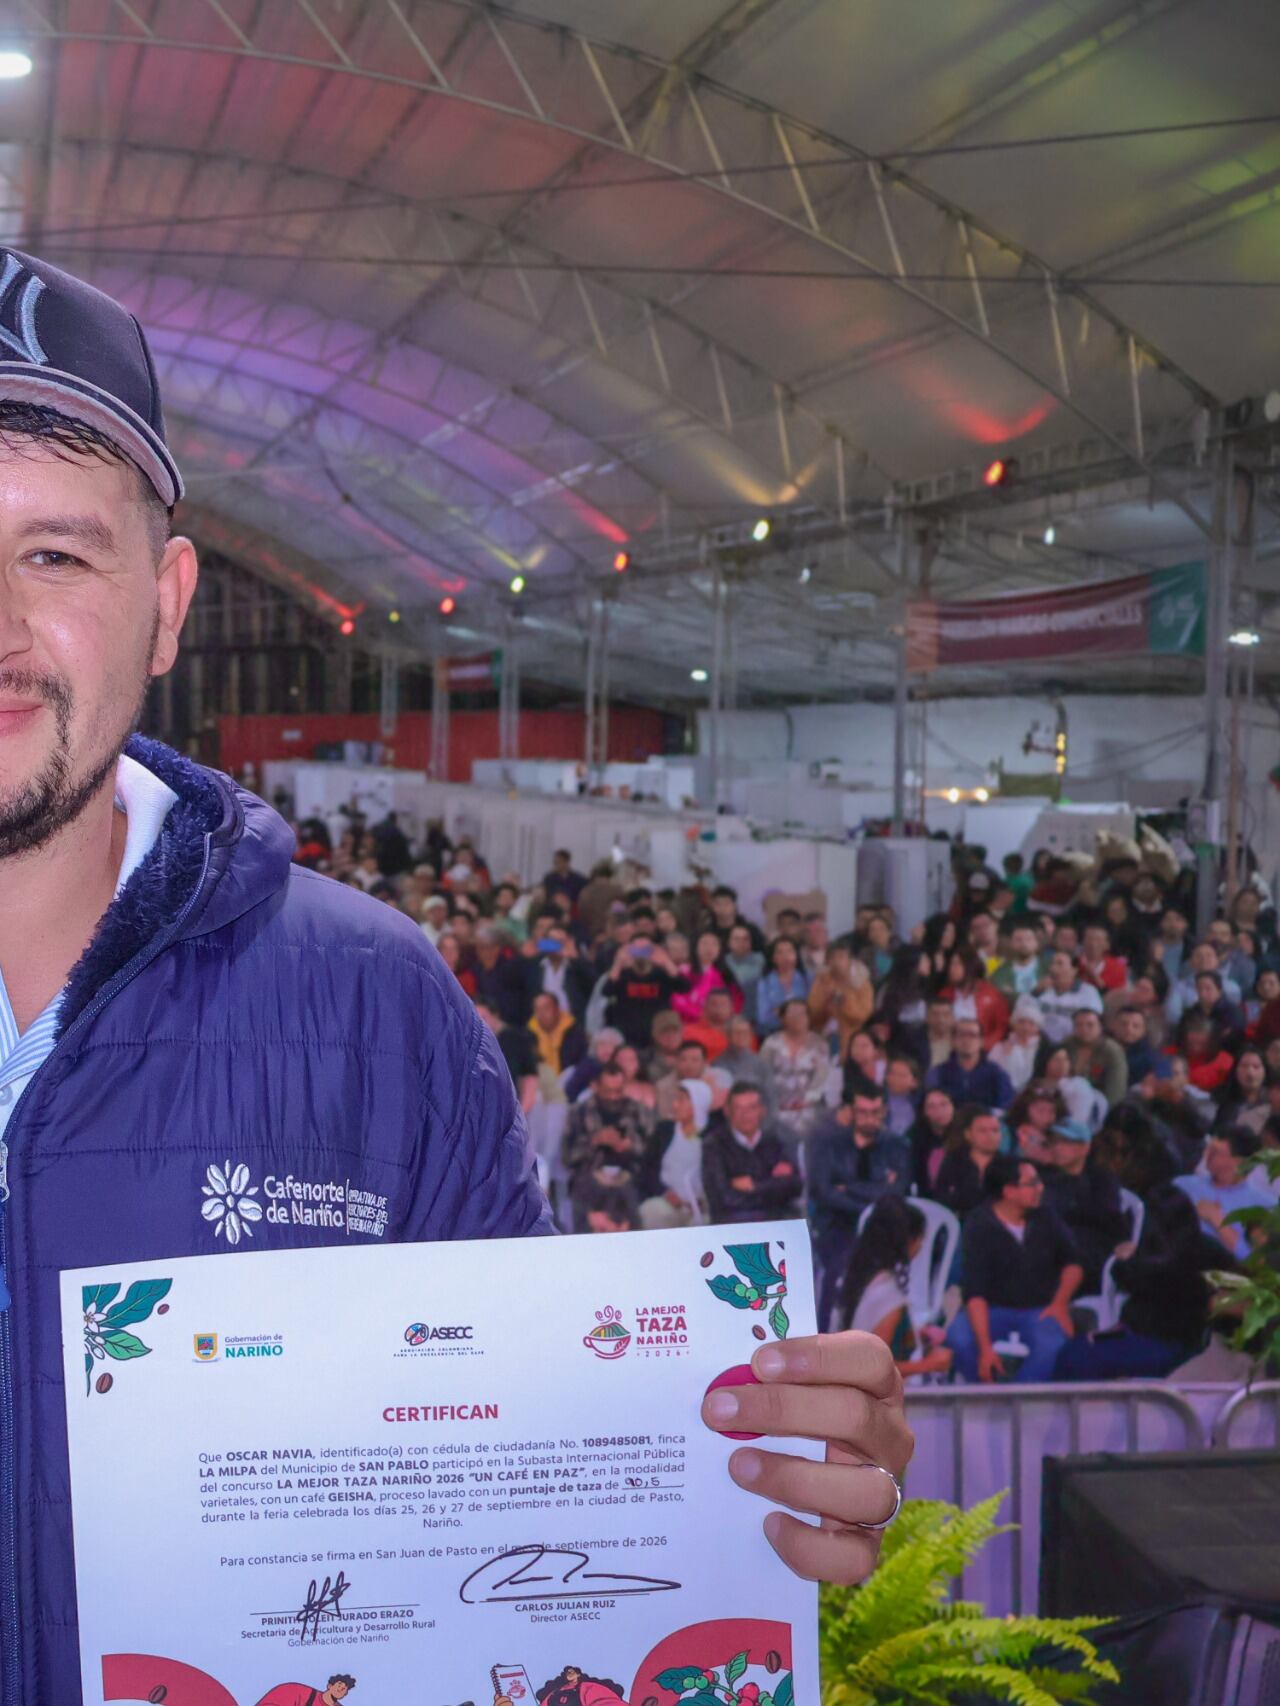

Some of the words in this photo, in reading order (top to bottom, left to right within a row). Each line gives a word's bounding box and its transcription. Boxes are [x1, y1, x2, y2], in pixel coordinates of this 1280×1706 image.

[263, 1174, 345, 1203] Cafenorte
[266, 1200, 289, 1224] de
[292, 1202, 345, 1227] Nariño
[635, 1307, 649, 1316] LA
[651, 1305, 686, 1315] MEJOR
[636, 1316, 687, 1332] TAZA
[224, 1334, 272, 1343] Gobernación
[429, 1326, 473, 1340] ASECC
[636, 1332, 688, 1345] NARIÑO
[225, 1342, 283, 1358] NARIÑO
[382, 1404, 498, 1422] CERTIFICAN
[198, 1451, 222, 1466] Que
[226, 1449, 268, 1461] OSCAR
[272, 1448, 315, 1462] NAVIA,
[320, 1443, 402, 1459] identificado(a)
[407, 1445, 428, 1454] con
[432, 1441, 470, 1453] cédula
[474, 1440, 489, 1452] de
[493, 1438, 555, 1451] ciudadanía
[560, 1438, 578, 1449] No.
[582, 1435, 653, 1449] 1089485081,
[658, 1433, 685, 1445] finca
[199, 1467, 215, 1478] LA
[218, 1465, 257, 1477] MILPA
[260, 1463, 278, 1475] del
[281, 1462, 337, 1476] Municipio
[340, 1460, 355, 1472] de
[358, 1460, 384, 1471] SAN
[388, 1458, 429, 1470] PABLO
[432, 1455, 483, 1472] participó
[486, 1457, 500, 1466] en
[504, 1454, 514, 1465] la
[518, 1453, 562, 1465] Subasta
[566, 1448, 640, 1463] Internacional
[644, 1447, 685, 1460] Pública
[200, 1480, 217, 1493] del
[221, 1482, 272, 1492] concurso
[277, 1478, 292, 1489] LA
[297, 1477, 339, 1489] MEJOR
[344, 1475, 378, 1487] TAZA
[382, 1470, 432, 1485] NARIÑO
[436, 1472, 464, 1483] 2026
[497, 1466, 528, 1481] CAFÉ
[532, 1468, 549, 1479] EN
[592, 1468, 606, 1477] en
[610, 1464, 620, 1476] la
[624, 1462, 684, 1476] modalidad
[200, 1495, 257, 1509] varietales,
[260, 1496, 281, 1505] con
[284, 1496, 298, 1504] un
[301, 1491, 325, 1504] café
[328, 1490, 376, 1504] GEISHA,
[379, 1490, 425, 1504] proceso
[428, 1485, 465, 1498] lavado
[468, 1487, 489, 1496] con
[492, 1487, 506, 1495] un
[509, 1483, 556, 1498] puntaje
[558, 1481, 574, 1492] de
[576, 1481, 602, 1492] taza
[604, 1479, 618, 1490] de
[201, 1511, 245, 1523] durante
[250, 1509, 259, 1521] la
[263, 1509, 289, 1520] feria
[293, 1505, 348, 1519] celebrada
[353, 1505, 370, 1516] los
[374, 1504, 397, 1516] días
[400, 1503, 417, 1517] 25,
[422, 1502, 435, 1513] 26
[439, 1504, 446, 1516] y
[450, 1501, 464, 1512] 27
[468, 1500, 482, 1511] de
[486, 1497, 551, 1514] septiembre
[555, 1499, 569, 1508] en
[574, 1495, 584, 1507] la
[588, 1493, 626, 1506] ciudad
[630, 1493, 645, 1504] de
[649, 1492, 684, 1506] Pasto,
[423, 1516, 462, 1529] Nariño.
[220, 1556, 244, 1567] Para
[247, 1553, 308, 1565] constancia
[311, 1554, 323, 1563] se
[326, 1550, 355, 1562] firma
[358, 1552, 372, 1560] en
[376, 1549, 396, 1560] San
[400, 1548, 425, 1558] Juan
[428, 1545, 443, 1557] de
[446, 1545, 477, 1556] Pasto
[480, 1546, 494, 1555] en
[497, 1542, 508, 1554] el
[555, 1537, 619, 1554] septiembre
[622, 1536, 636, 1548] de
[640, 1536, 667, 1547] 2026
[514, 1602, 553, 1613] CARLOS
[556, 1600, 590, 1611] JULIAN
[592, 1599, 615, 1609] RUIZ
[339, 1610, 377, 1621] JURADO
[380, 1609, 414, 1619] ERAZO
[530, 1613, 568, 1623] Director
[570, 1611, 600, 1621] ASECC
[241, 1628, 286, 1639] Secretaria
[288, 1627, 300, 1636] de
[304, 1625, 353, 1638] Agicultura
[355, 1626, 361, 1636] y
[363, 1621, 410, 1632] Desarrollo
[412, 1619, 435, 1630] Rural
[287, 1635, 344, 1647] Gobernación
[346, 1634, 358, 1644] de
[360, 1633, 389, 1643] Nariño
